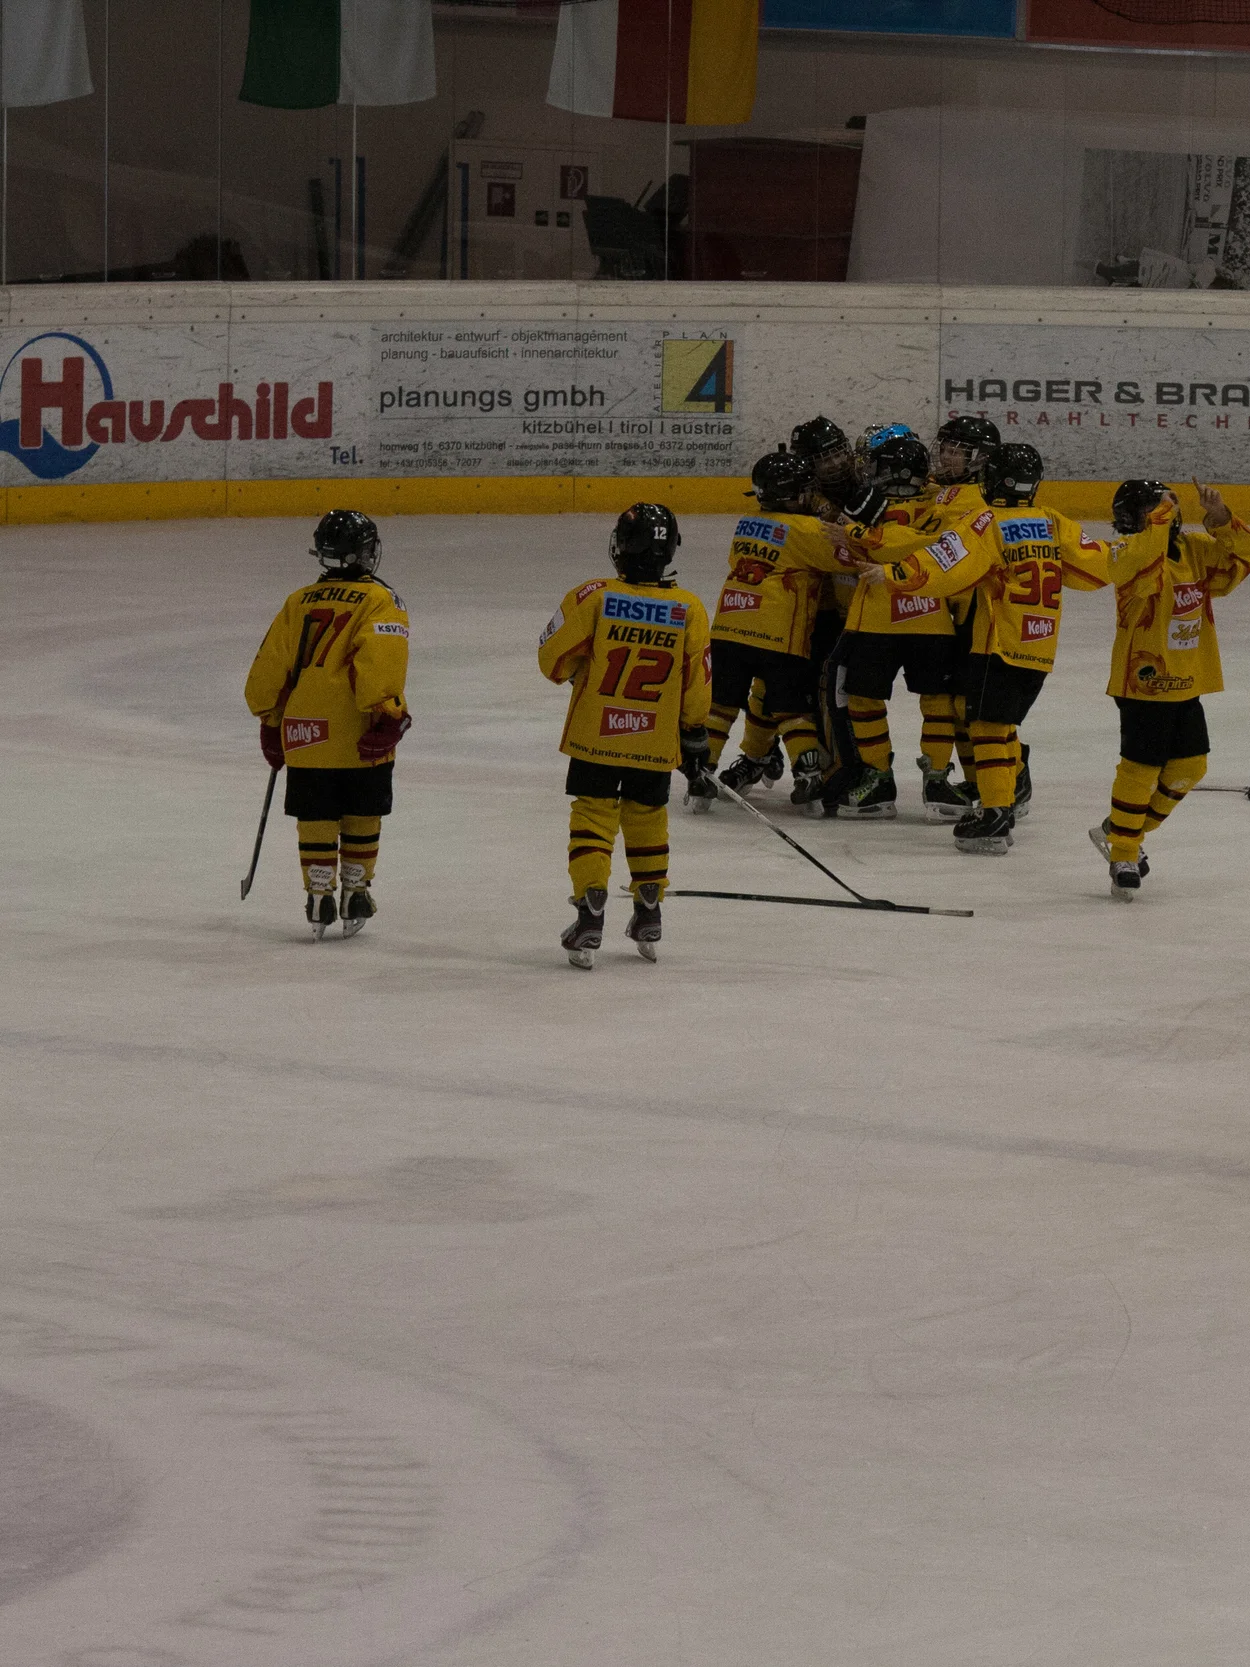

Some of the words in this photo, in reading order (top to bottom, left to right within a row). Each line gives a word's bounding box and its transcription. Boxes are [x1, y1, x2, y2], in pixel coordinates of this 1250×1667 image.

[380, 330, 443, 342] architektur
[455, 330, 500, 342] entwurf
[511, 330, 627, 344] objektmanagement
[662, 331, 727, 339] PLAN
[381, 348, 428, 361] planung
[440, 347, 509, 360] bauaufsicht
[521, 348, 618, 359] innenarchitektur
[653, 340, 662, 413] ATELIER
[380, 385, 512, 413] planungs
[524, 385, 605, 412] gmbh
[944, 378, 1102, 403] HAGER
[1113, 381, 1145, 404] &
[19, 356, 334, 448] Hauschild
[522, 420, 602, 434] kitzbühel
[620, 420, 653, 434] tirol
[671, 421, 733, 435] austria
[330, 446, 364, 465] Tel.
[438, 442, 462, 450] 6370
[464, 441, 506, 451] kitzbühel
[653, 526, 667, 540] 12
[1009, 560, 1062, 610] 32
[301, 587, 368, 604] TISCHLER
[723, 592, 755, 609] Kelly's
[604, 597, 668, 624] ERSTE
[607, 625, 678, 648] KIEWEG
[1027, 620, 1053, 637] Kelly's
[301, 608, 354, 669] 71
[597, 646, 675, 702] 12
[608, 713, 649, 731] Kelly's
[286, 721, 321, 743] Kelly's
